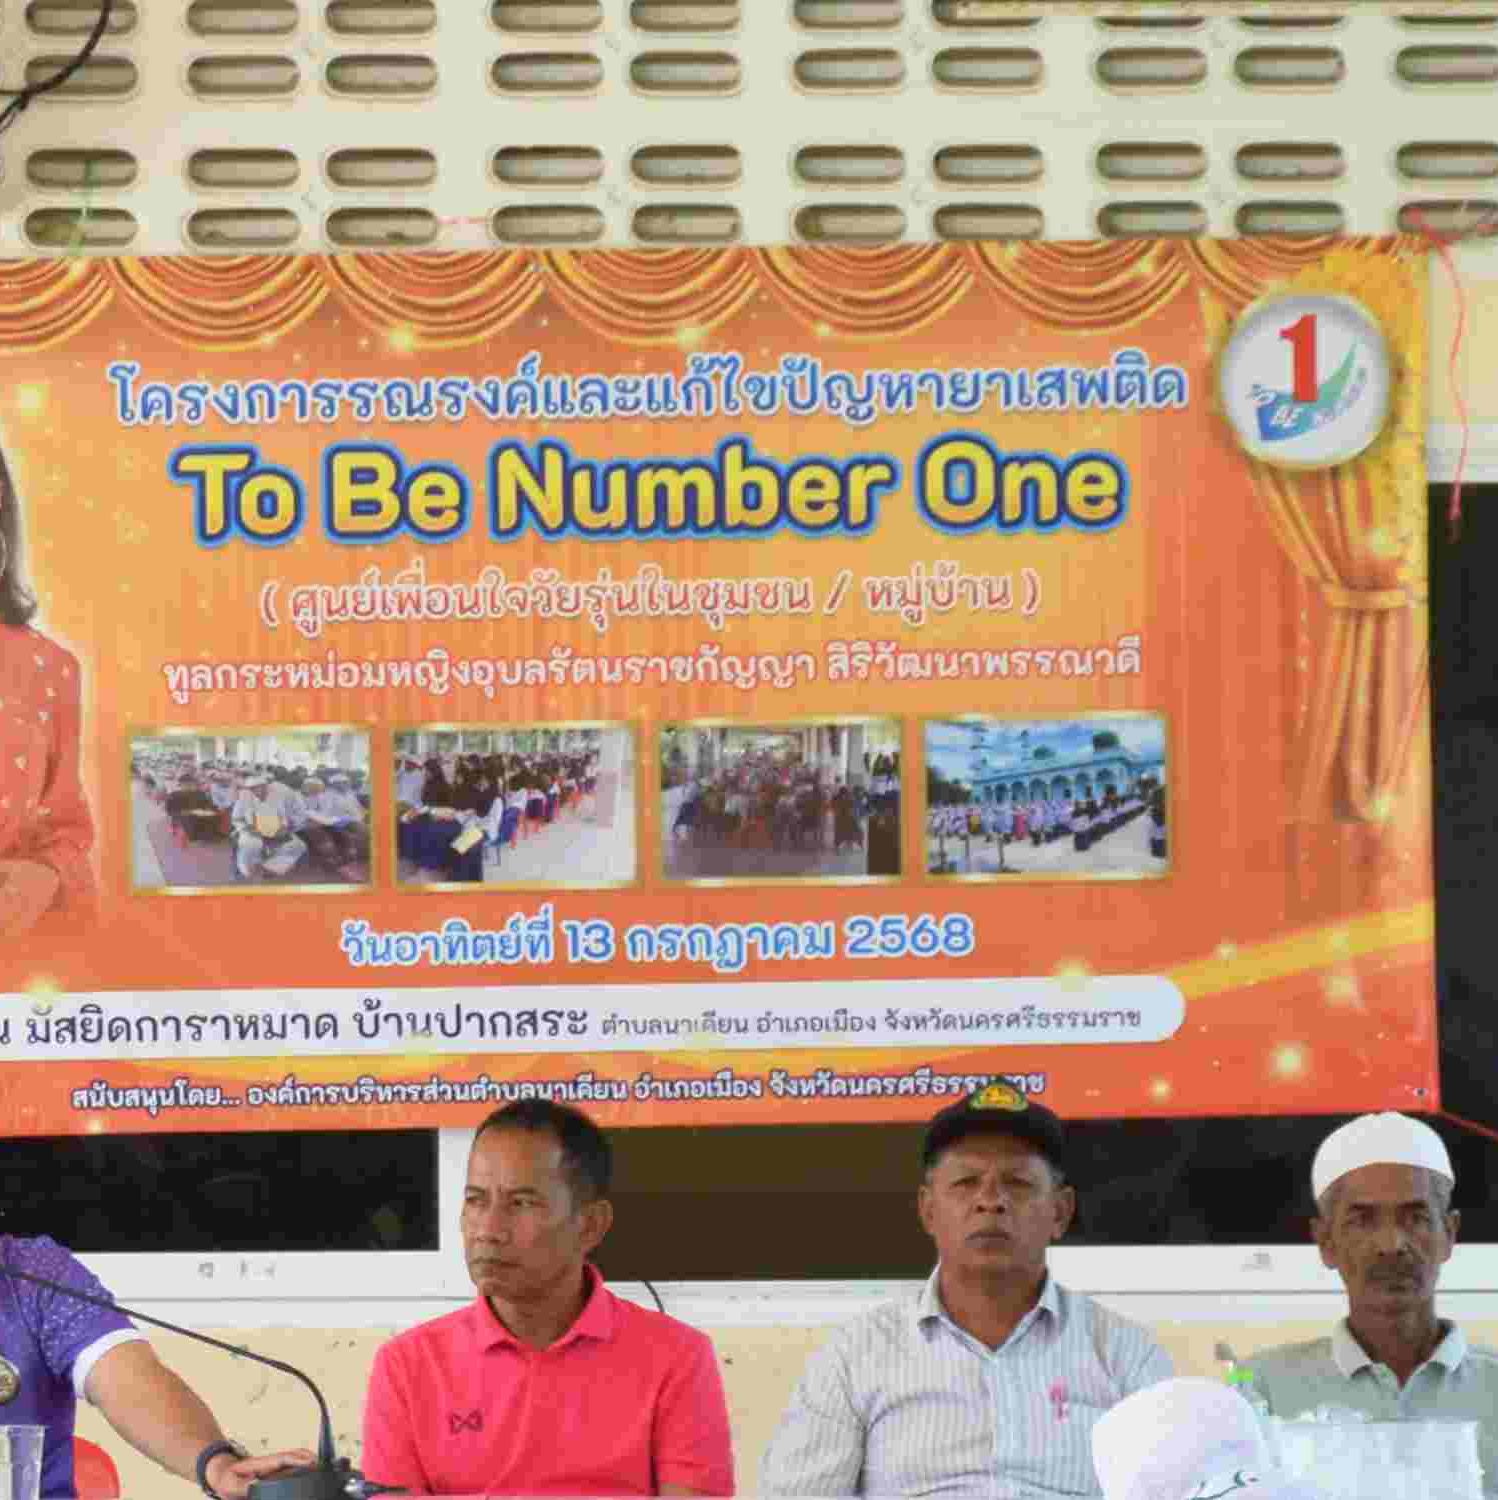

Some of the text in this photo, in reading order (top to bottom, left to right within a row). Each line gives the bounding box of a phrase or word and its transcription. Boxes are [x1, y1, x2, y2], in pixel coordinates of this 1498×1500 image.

[107, 348, 1188, 426] โครงการรณรงค์และแก้ไขปัญหายาเสพติด
[171, 433, 1128, 543] To Be Number One
[290, 557, 812, 637] ศูนย์เพื่อนใจวัยรุ่นในชุมชน
[863, 560, 1012, 624] หมู่บ้าน
[164, 635, 1141, 703] ทูลกระหม่อมหญิงอุบลรัตนราชกัญญา สิริวัฒนาพรรณวดี
[343, 905, 974, 971] วันอาทิตย์ที่ 13 กรกฎาคม 2568
[26, 1006, 340, 1046] มัสยิดการาหมาด
[353, 998, 588, 1042] บ้านปากสระ
[757, 1008, 877, 1034] อำเภอเมือง
[884, 1006, 1142, 1032] จังหวัดนครศรีธรรมราช
[72, 1076, 241, 1117] สนับสนุนโดย...
[248, 1071, 629, 1108] องค์การบริหารส่วนตำบลนาเคียน
[634, 1070, 764, 1101] อำเภอเมือง
